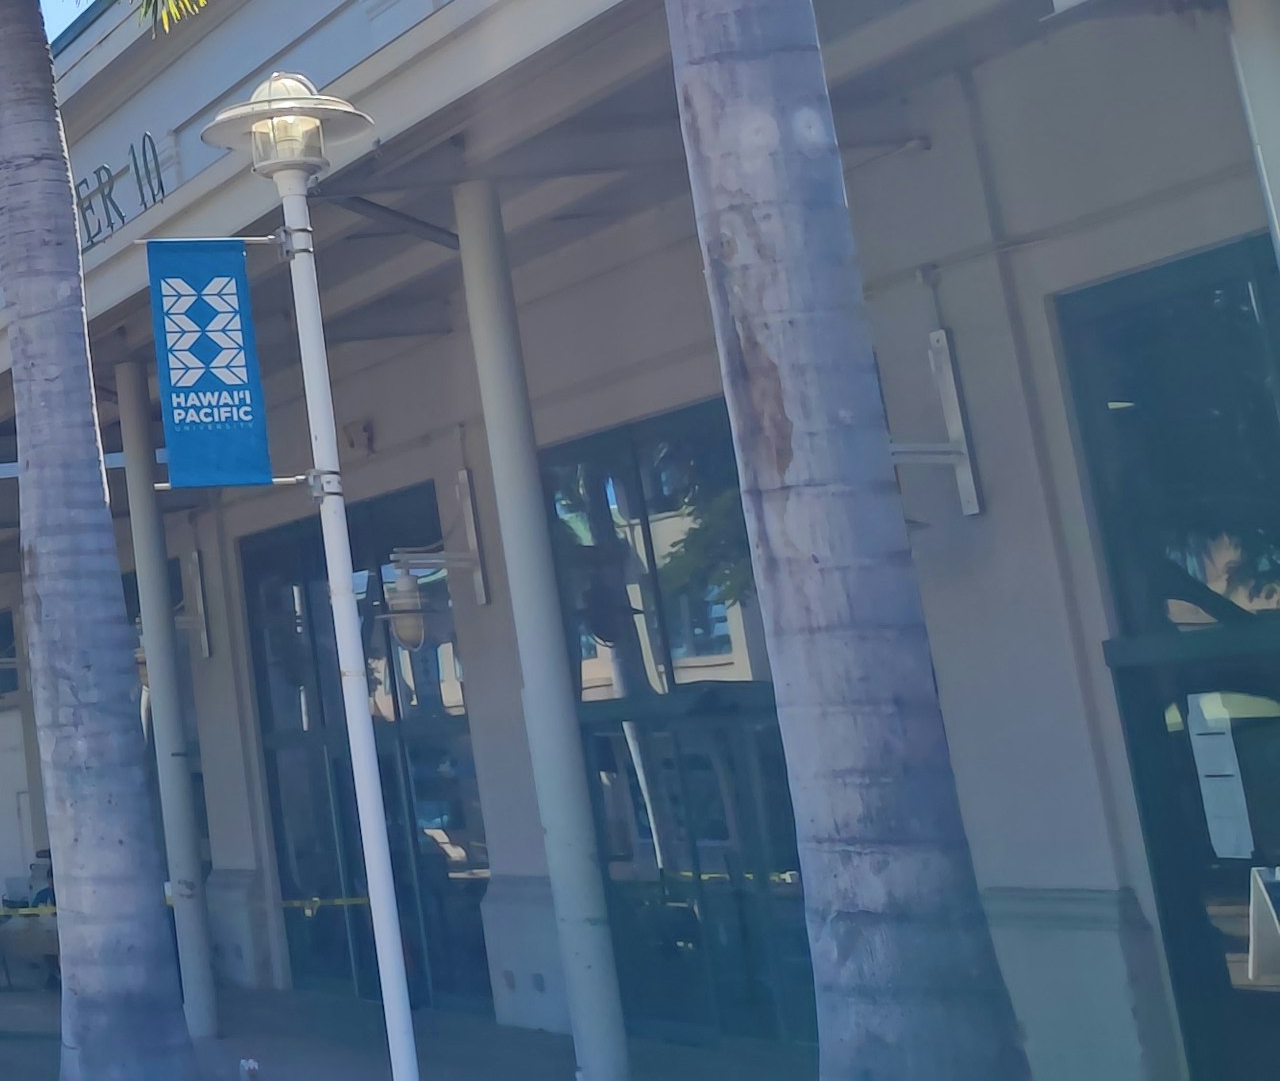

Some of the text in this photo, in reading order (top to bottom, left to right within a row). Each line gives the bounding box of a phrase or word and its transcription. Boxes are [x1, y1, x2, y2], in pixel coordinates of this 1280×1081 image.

[75, 130, 165, 243] ER 10
[171, 389, 252, 408] HAWAI‘I
[173, 405, 254, 424] PACIFIC
